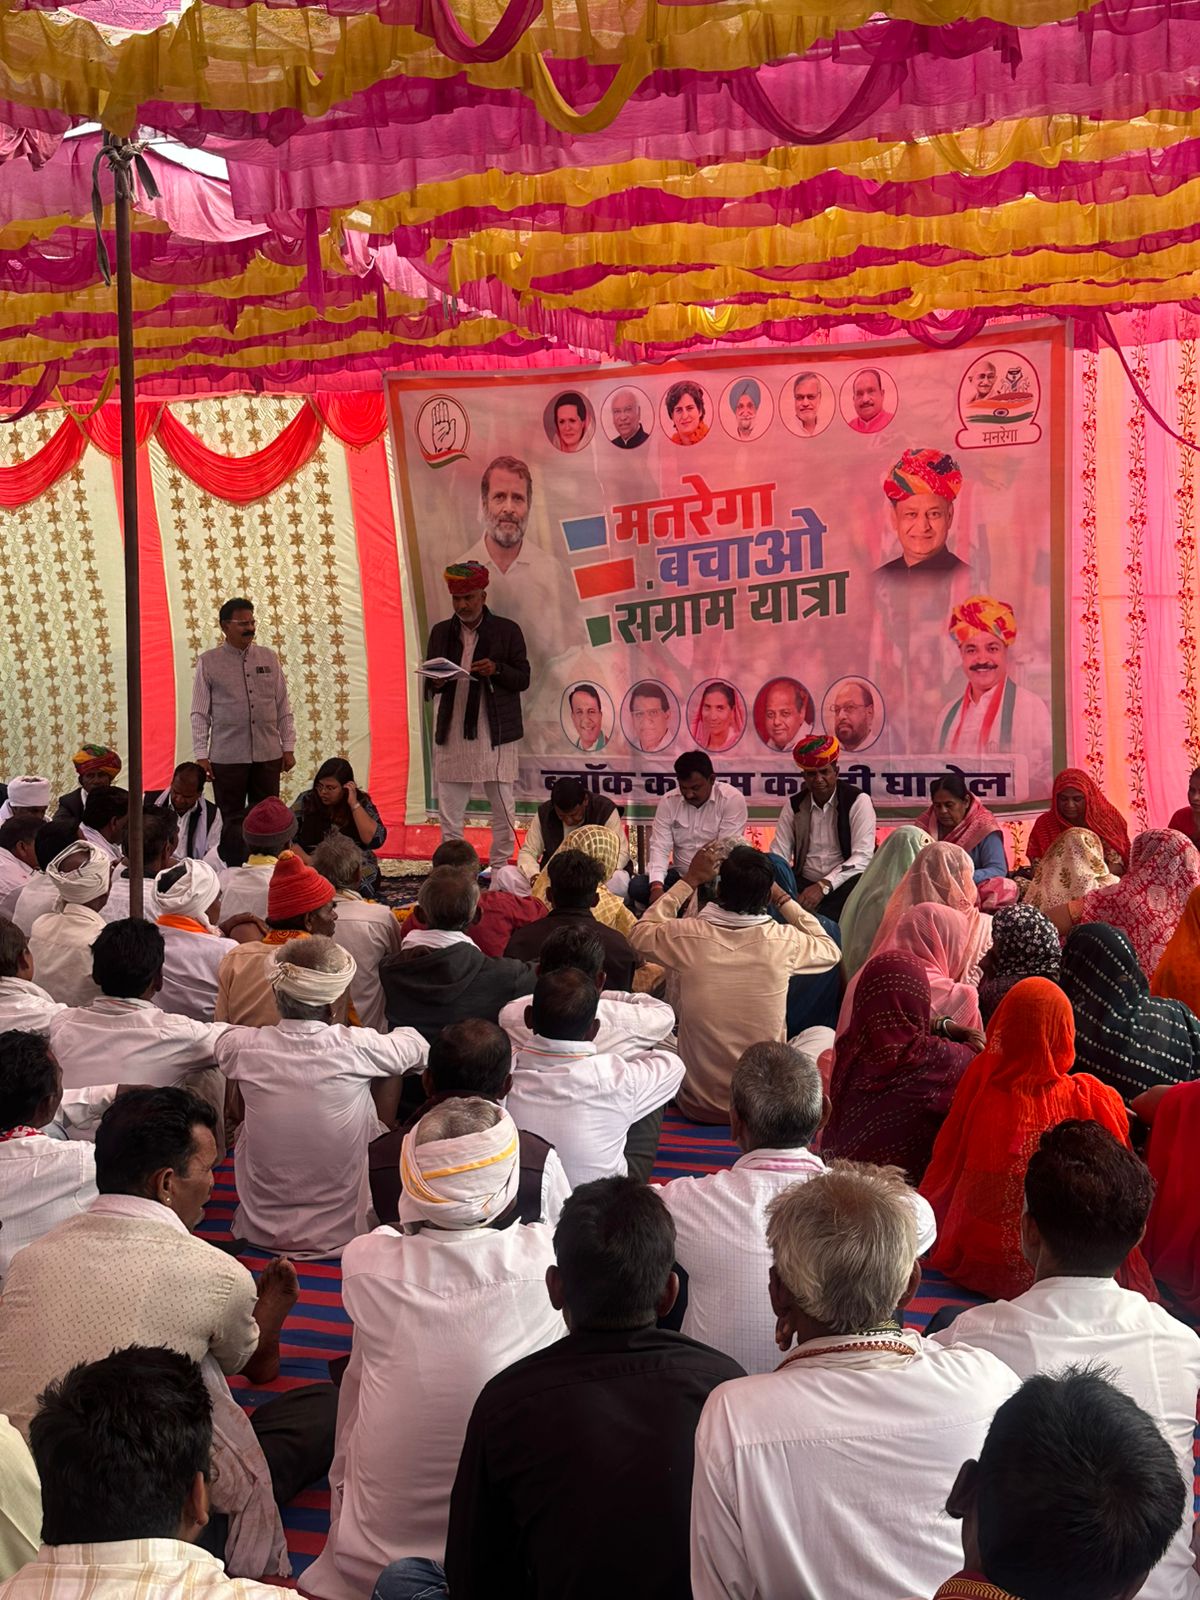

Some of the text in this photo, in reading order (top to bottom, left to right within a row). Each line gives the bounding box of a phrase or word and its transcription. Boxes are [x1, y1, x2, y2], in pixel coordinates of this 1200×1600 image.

[982, 426, 1018, 444] मनरेगा
[612, 473, 777, 545] मनरेगा
[656, 507, 828, 587] बचाओ
[614, 569, 851, 644] संग्राम यात्रा
[881, 764, 1011, 797] घाोल
